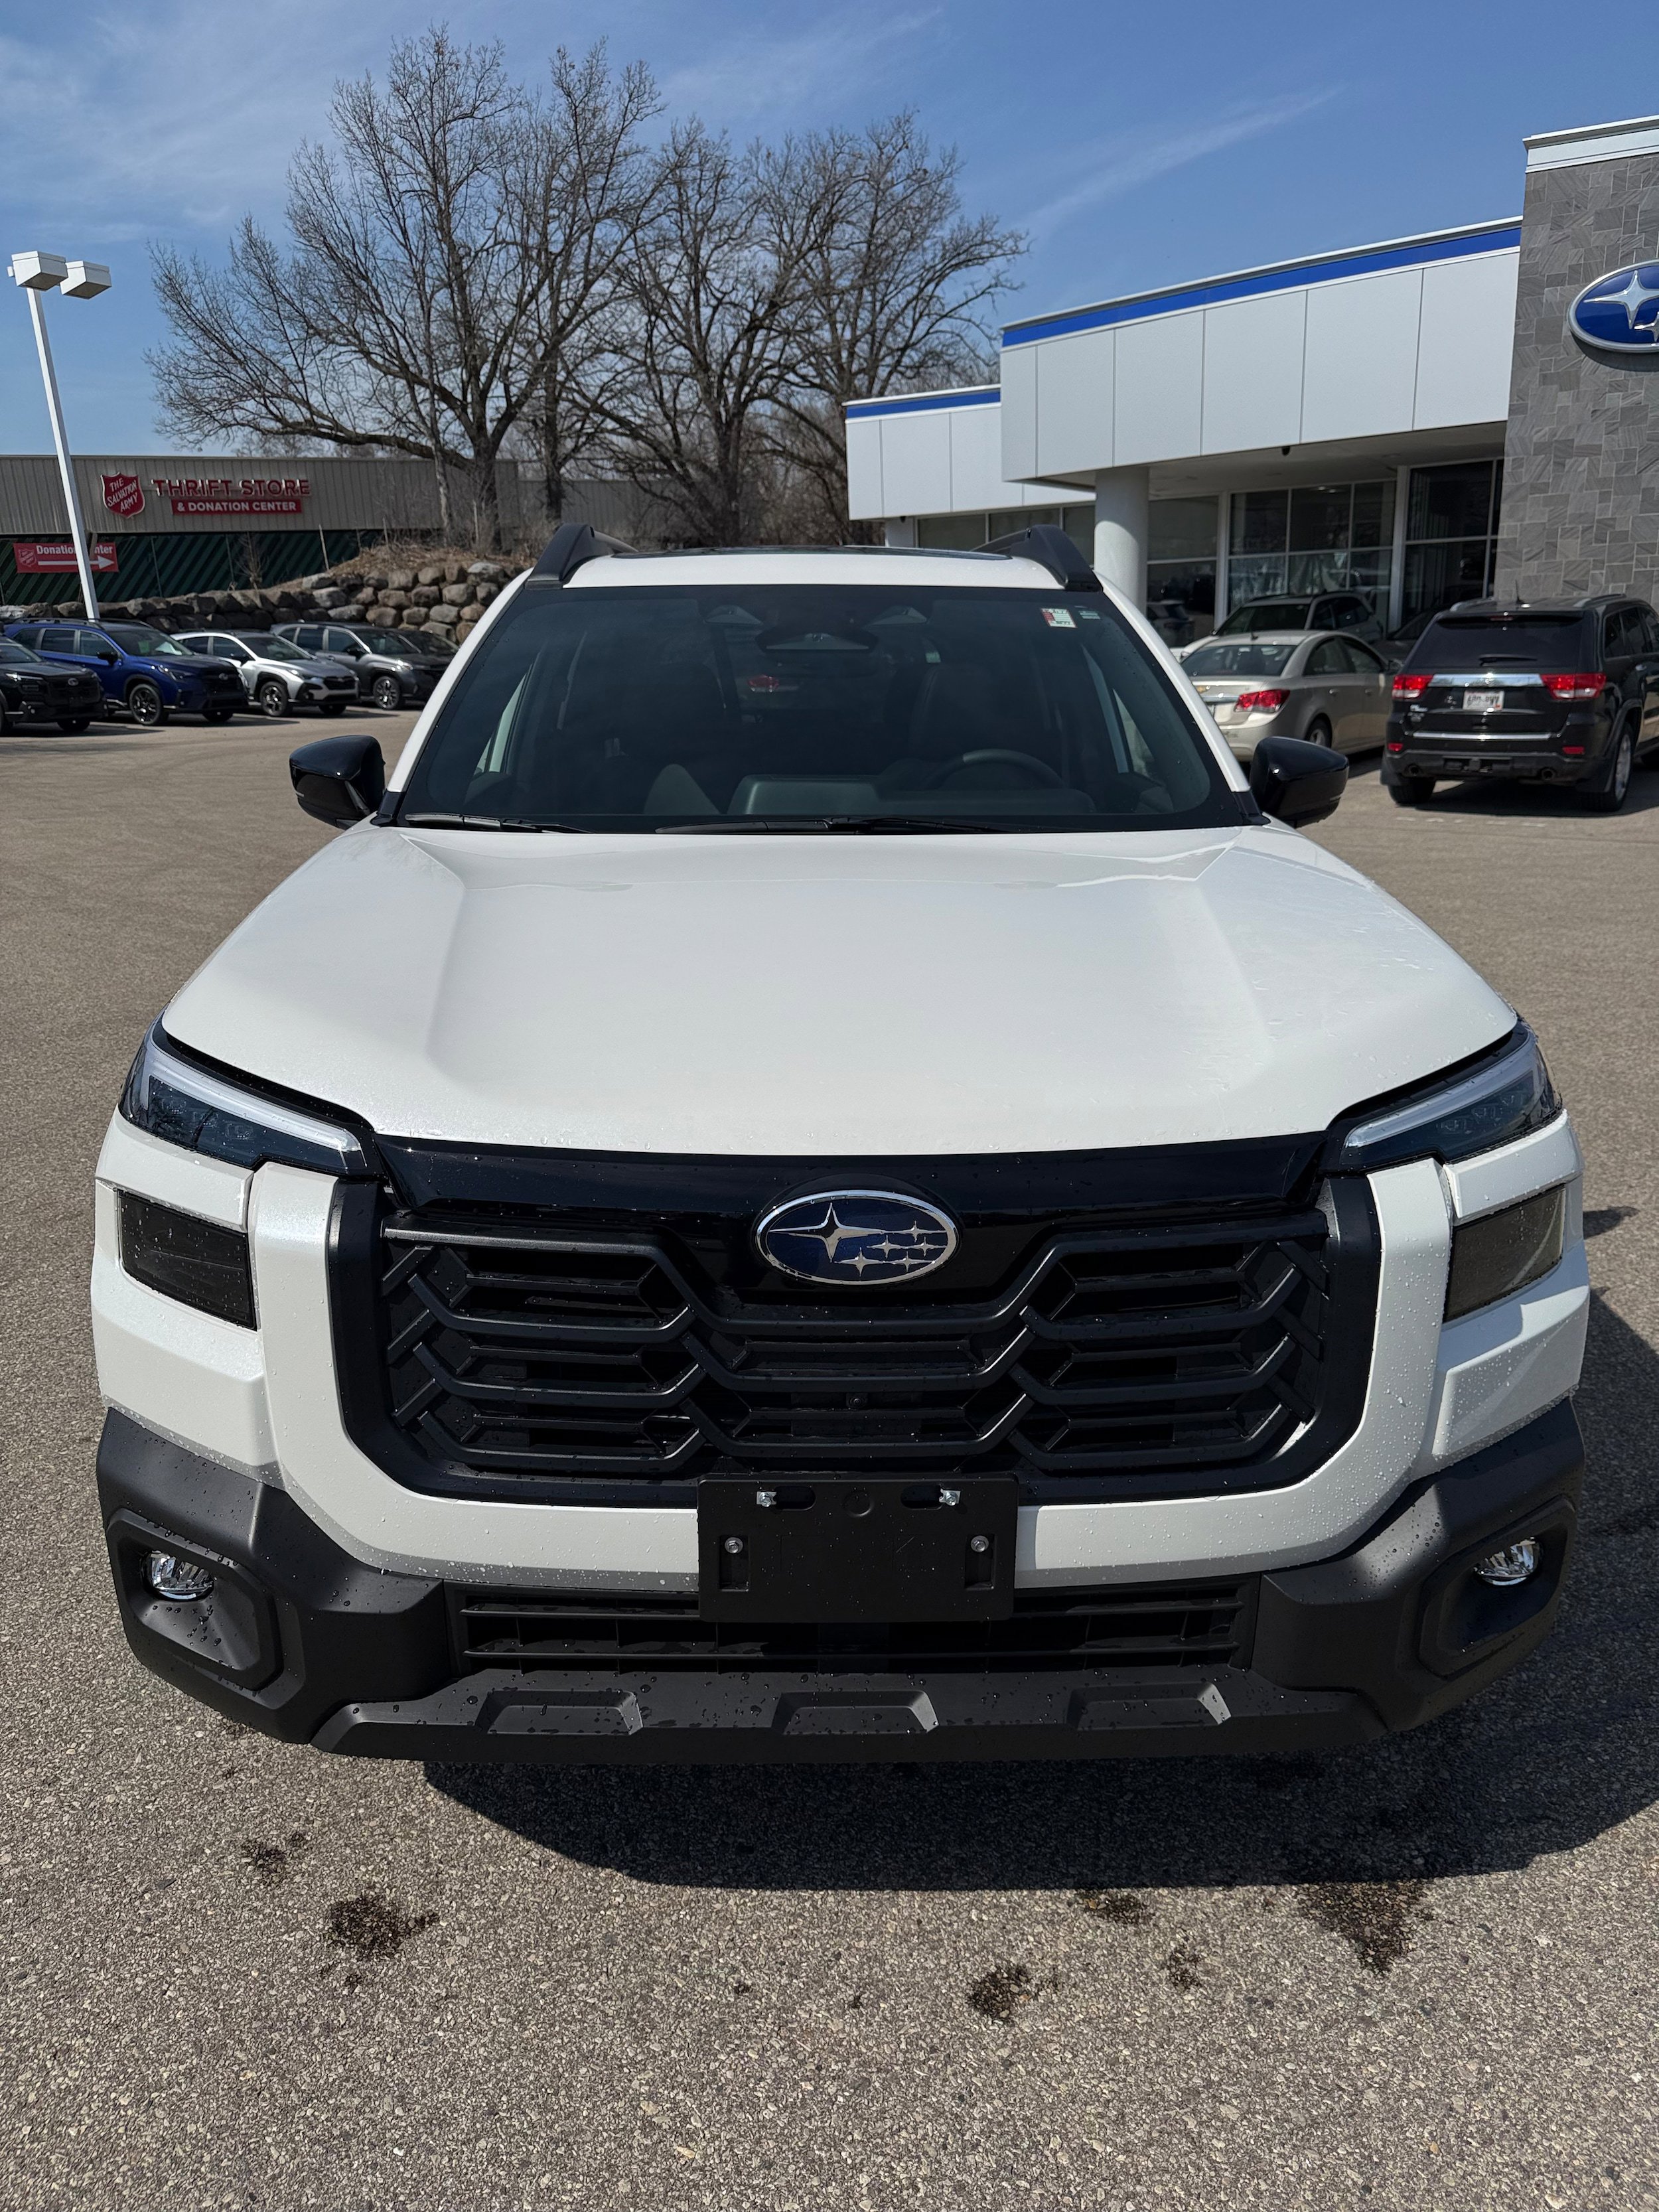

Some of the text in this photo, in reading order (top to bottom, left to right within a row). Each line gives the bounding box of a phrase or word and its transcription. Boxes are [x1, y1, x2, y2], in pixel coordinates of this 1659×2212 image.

[107, 479, 138, 506] SALVATION
[109, 477, 124, 492] THE
[151, 479, 311, 496] THRIFT STORE
[120, 492, 138, 512] ARMY
[177, 501, 297, 512] & DONATION CENTER
[36, 545, 76, 555] Donatio
